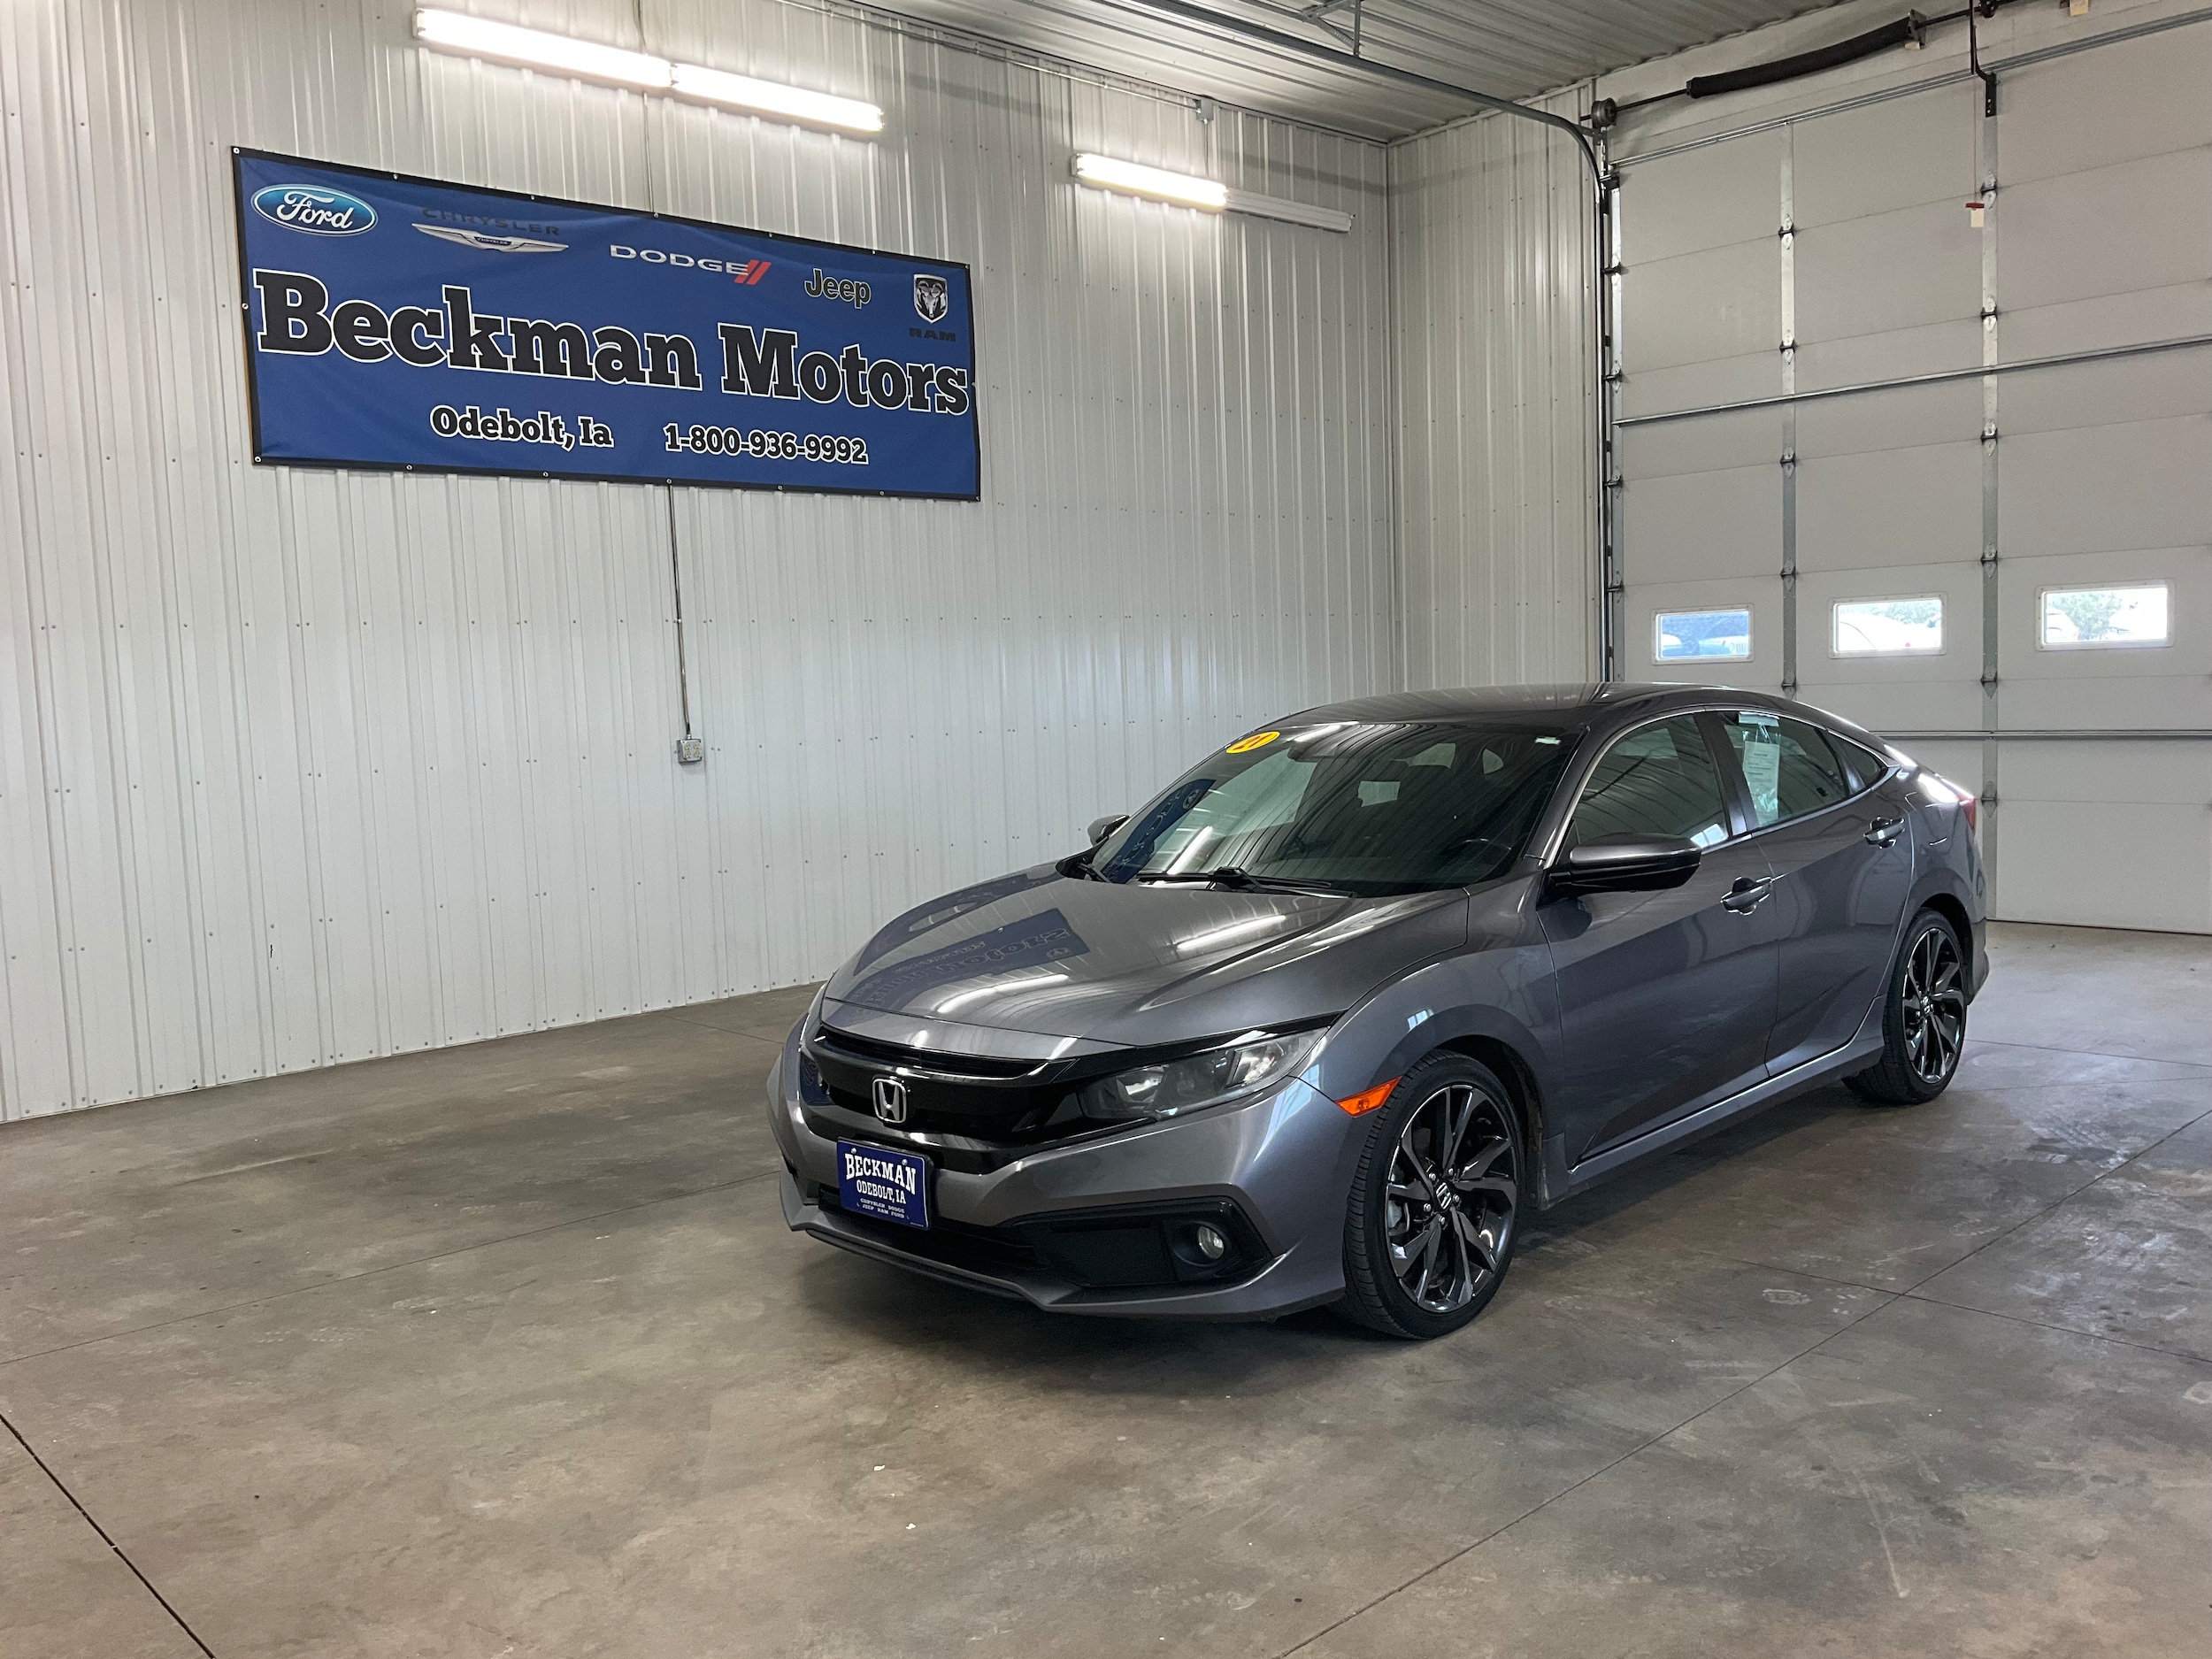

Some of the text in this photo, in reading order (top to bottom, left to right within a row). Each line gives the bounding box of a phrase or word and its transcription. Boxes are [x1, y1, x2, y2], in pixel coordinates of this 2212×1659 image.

[276, 190, 355, 230] Ford
[422, 206, 561, 236] CHRYSLER
[610, 244, 750, 275] DODGE
[804, 268, 872, 309] Jeep
[253, 268, 970, 416] Beckman Motors
[910, 327, 956, 342] RAM
[430, 404, 614, 452] Odebolt, Ia
[663, 422, 869, 465] 1-800-936-9992
[845, 1153, 916, 1195] BECKMAN
